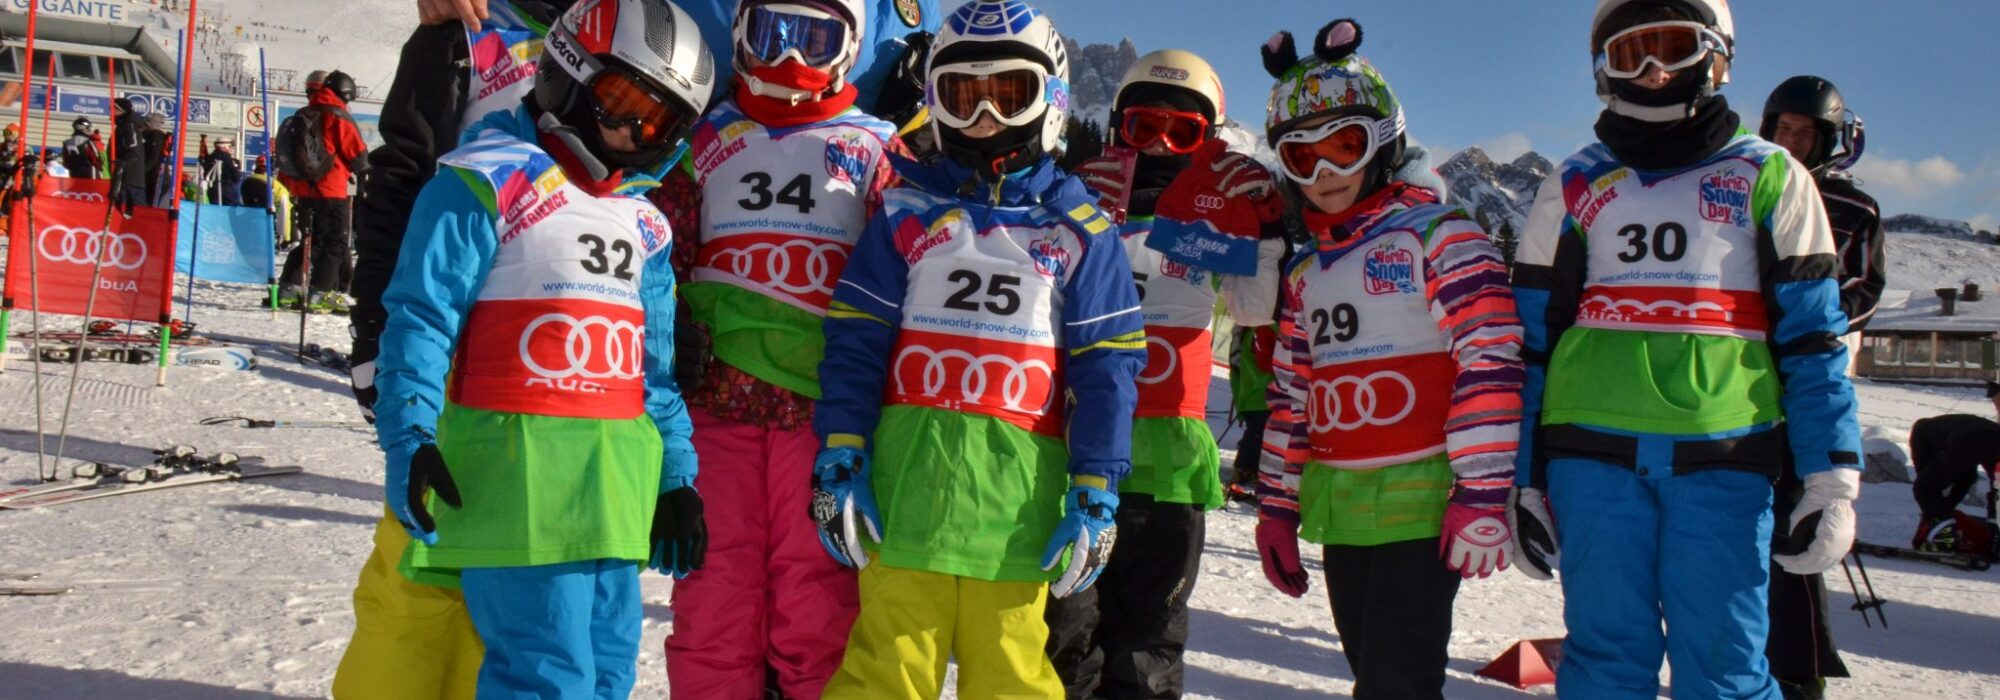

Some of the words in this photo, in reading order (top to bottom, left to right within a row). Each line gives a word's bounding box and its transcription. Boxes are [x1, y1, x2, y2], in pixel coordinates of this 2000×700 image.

[738, 171, 816, 215] 34
[1702, 182, 1746, 209] Snow
[501, 189, 569, 245] EXPERIENCE
[1707, 201, 1732, 222] Day
[711, 218, 848, 237] www.world-snow-day.com
[1616, 221, 1687, 263] 30
[576, 233, 634, 282] 32
[1366, 257, 1410, 281] Snow
[1371, 277, 1396, 292] Day
[1598, 269, 1719, 284] www.world-snow-day.com
[943, 269, 1022, 316] 25
[911, 313, 1049, 338] www.world-snow-day.com
[1311, 302, 1358, 347] 29
